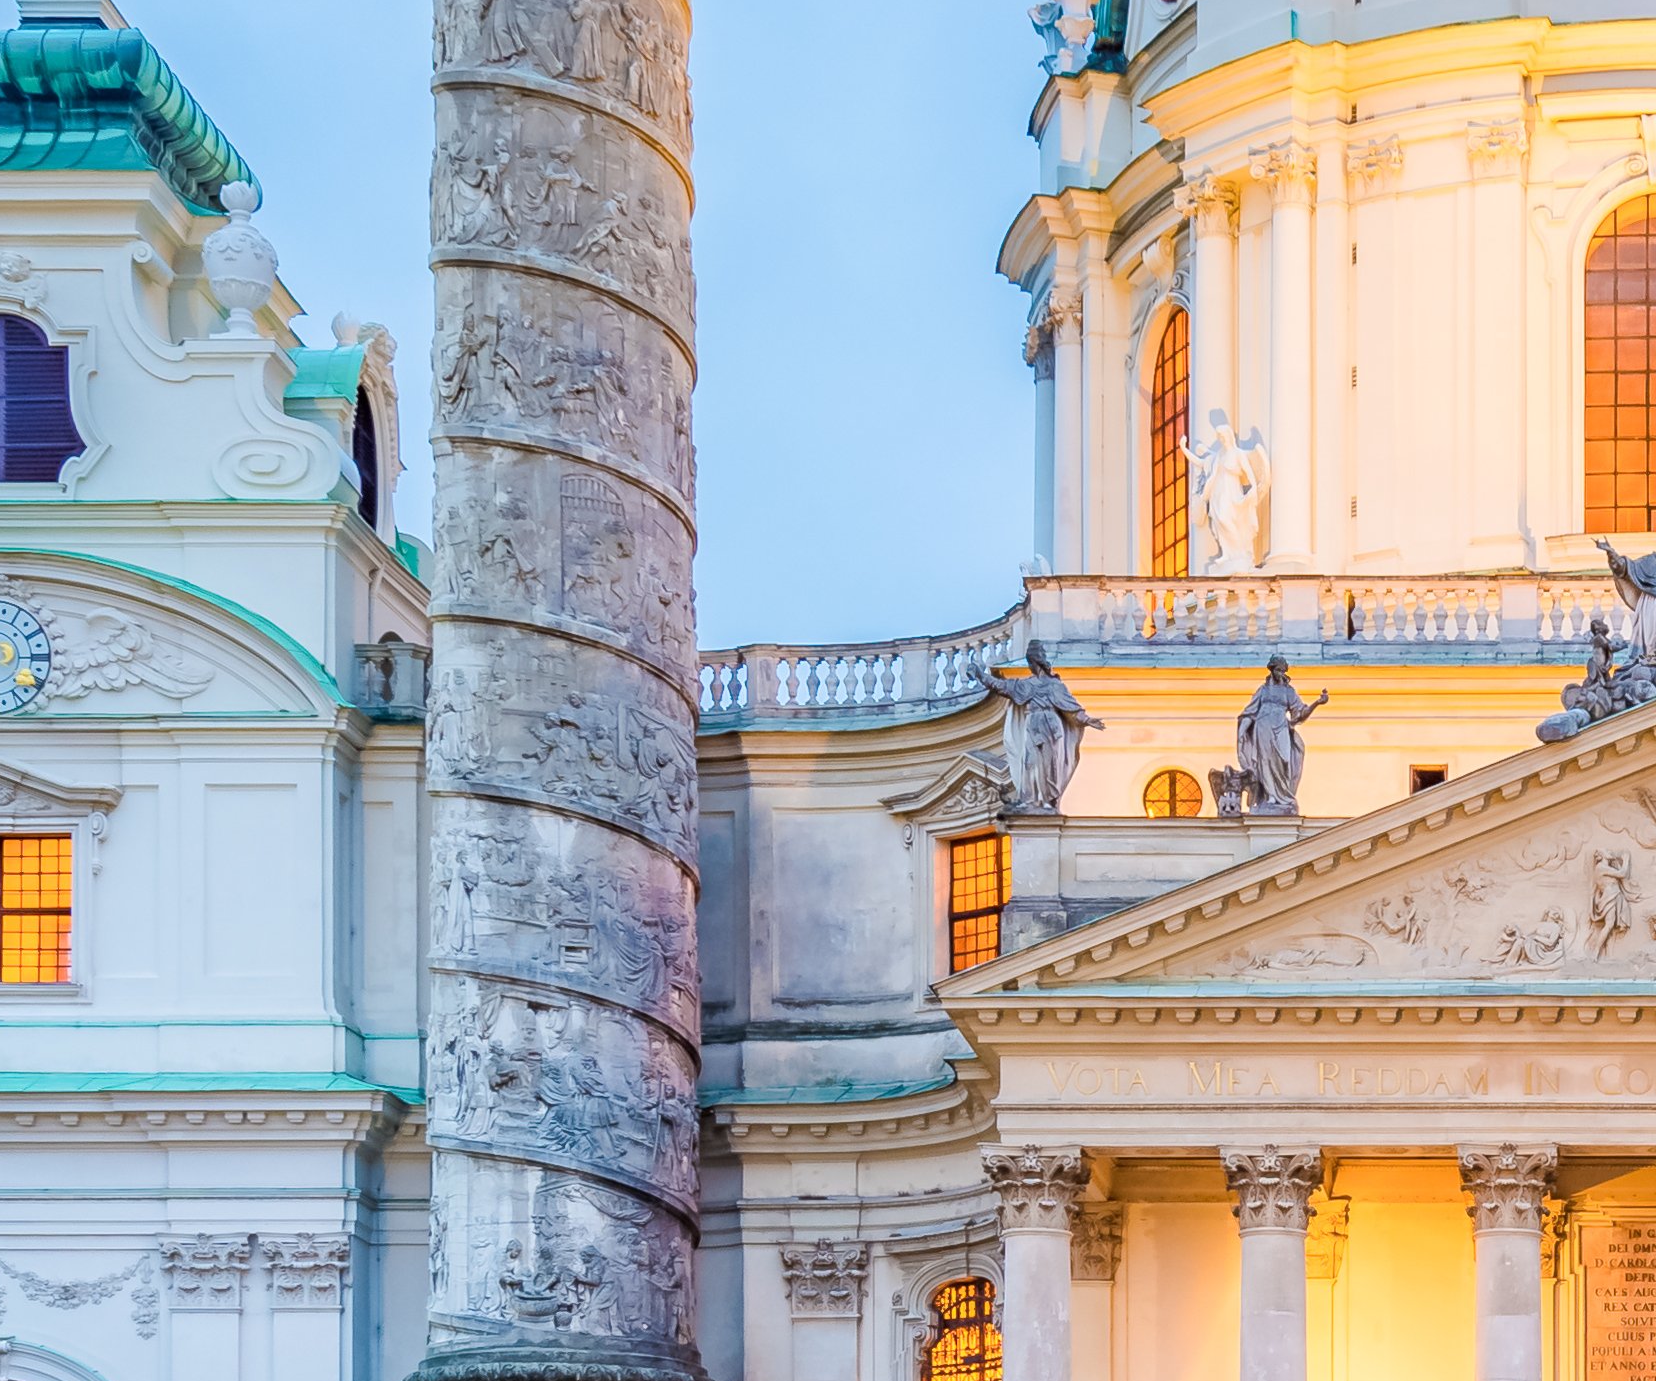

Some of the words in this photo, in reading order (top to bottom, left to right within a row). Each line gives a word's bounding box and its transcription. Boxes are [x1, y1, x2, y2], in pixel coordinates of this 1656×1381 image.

[1046, 1061, 1150, 1096] VOTA
[1188, 1061, 1280, 1095] MEA
[1317, 1061, 1489, 1095] REDDAM
[1524, 1061, 1561, 1095] IN
[1628, 1228, 1642, 1239] IN
[1608, 1243, 1628, 1253] DEI
[1603, 1302, 1628, 1312] REX
[1592, 1346, 1633, 1357] POPULI
[1590, 1361, 1606, 1371] ET
[1610, 1361, 1646, 1371] ANNO
